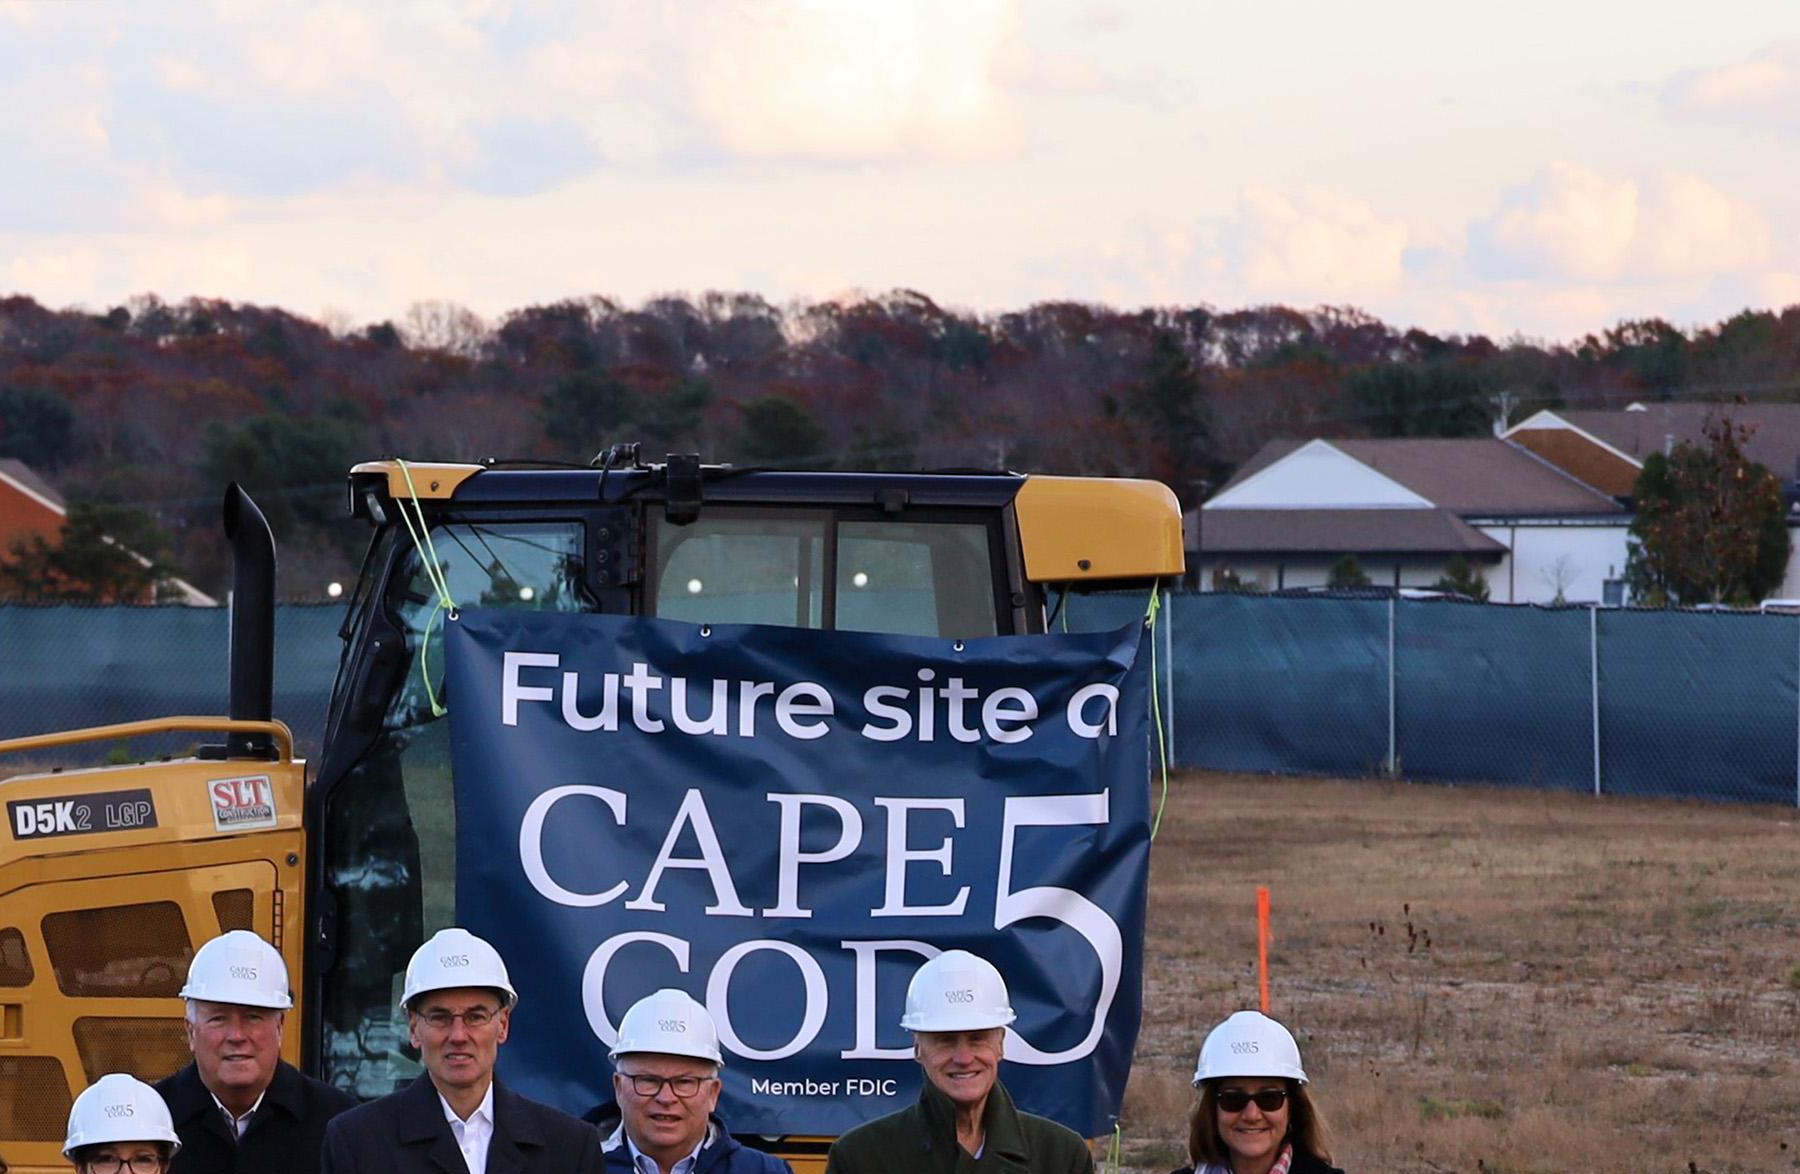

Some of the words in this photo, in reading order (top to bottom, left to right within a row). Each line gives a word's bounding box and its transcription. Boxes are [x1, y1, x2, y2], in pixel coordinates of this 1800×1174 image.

[502, 651, 835, 739] Future
[862, 667, 1039, 744] site
[105, 801, 151, 828] LGP
[213, 778, 268, 808] SLT
[518, 785, 971, 918] CAPE
[994, 788, 1123, 1065] 5
[751, 1078, 840, 1096] Member
[846, 1079, 897, 1096] FDIC
